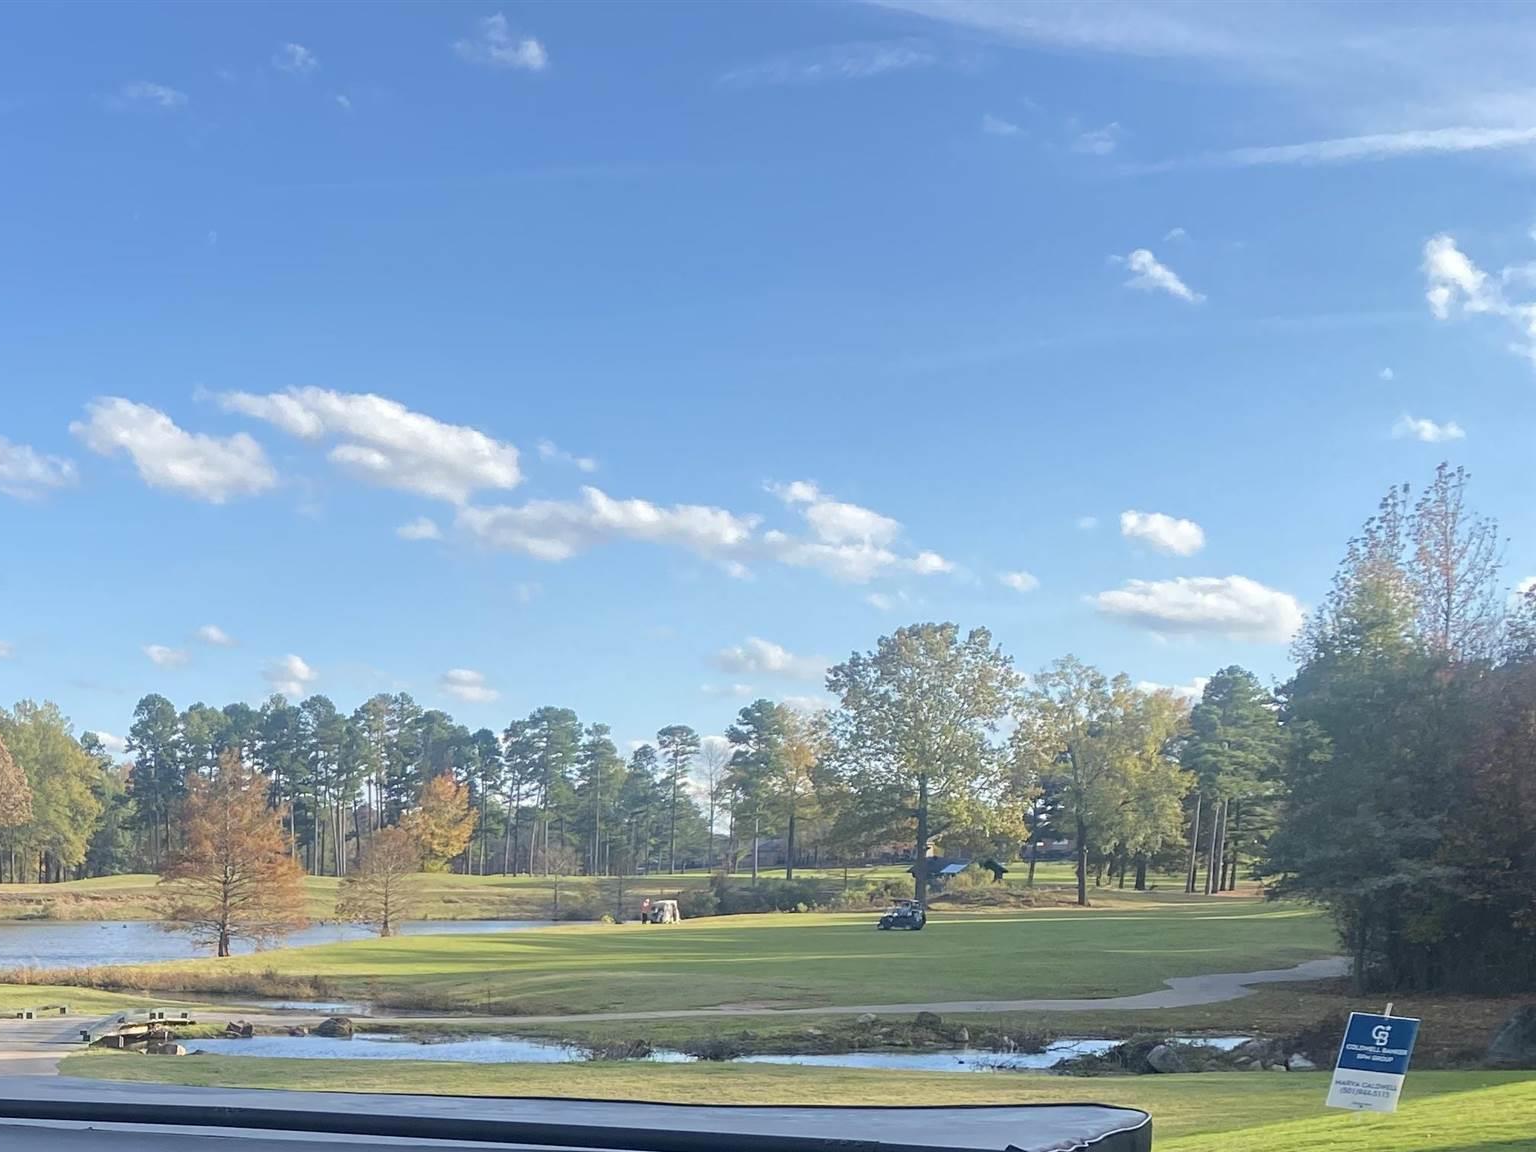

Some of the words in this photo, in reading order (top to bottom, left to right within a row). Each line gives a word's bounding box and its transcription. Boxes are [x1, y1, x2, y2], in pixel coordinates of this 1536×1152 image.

[1346, 1043, 1381, 1053] COLDWELL
[1382, 1047, 1408, 1056] BANKER
[1372, 1054, 1394, 1062] GROUP
